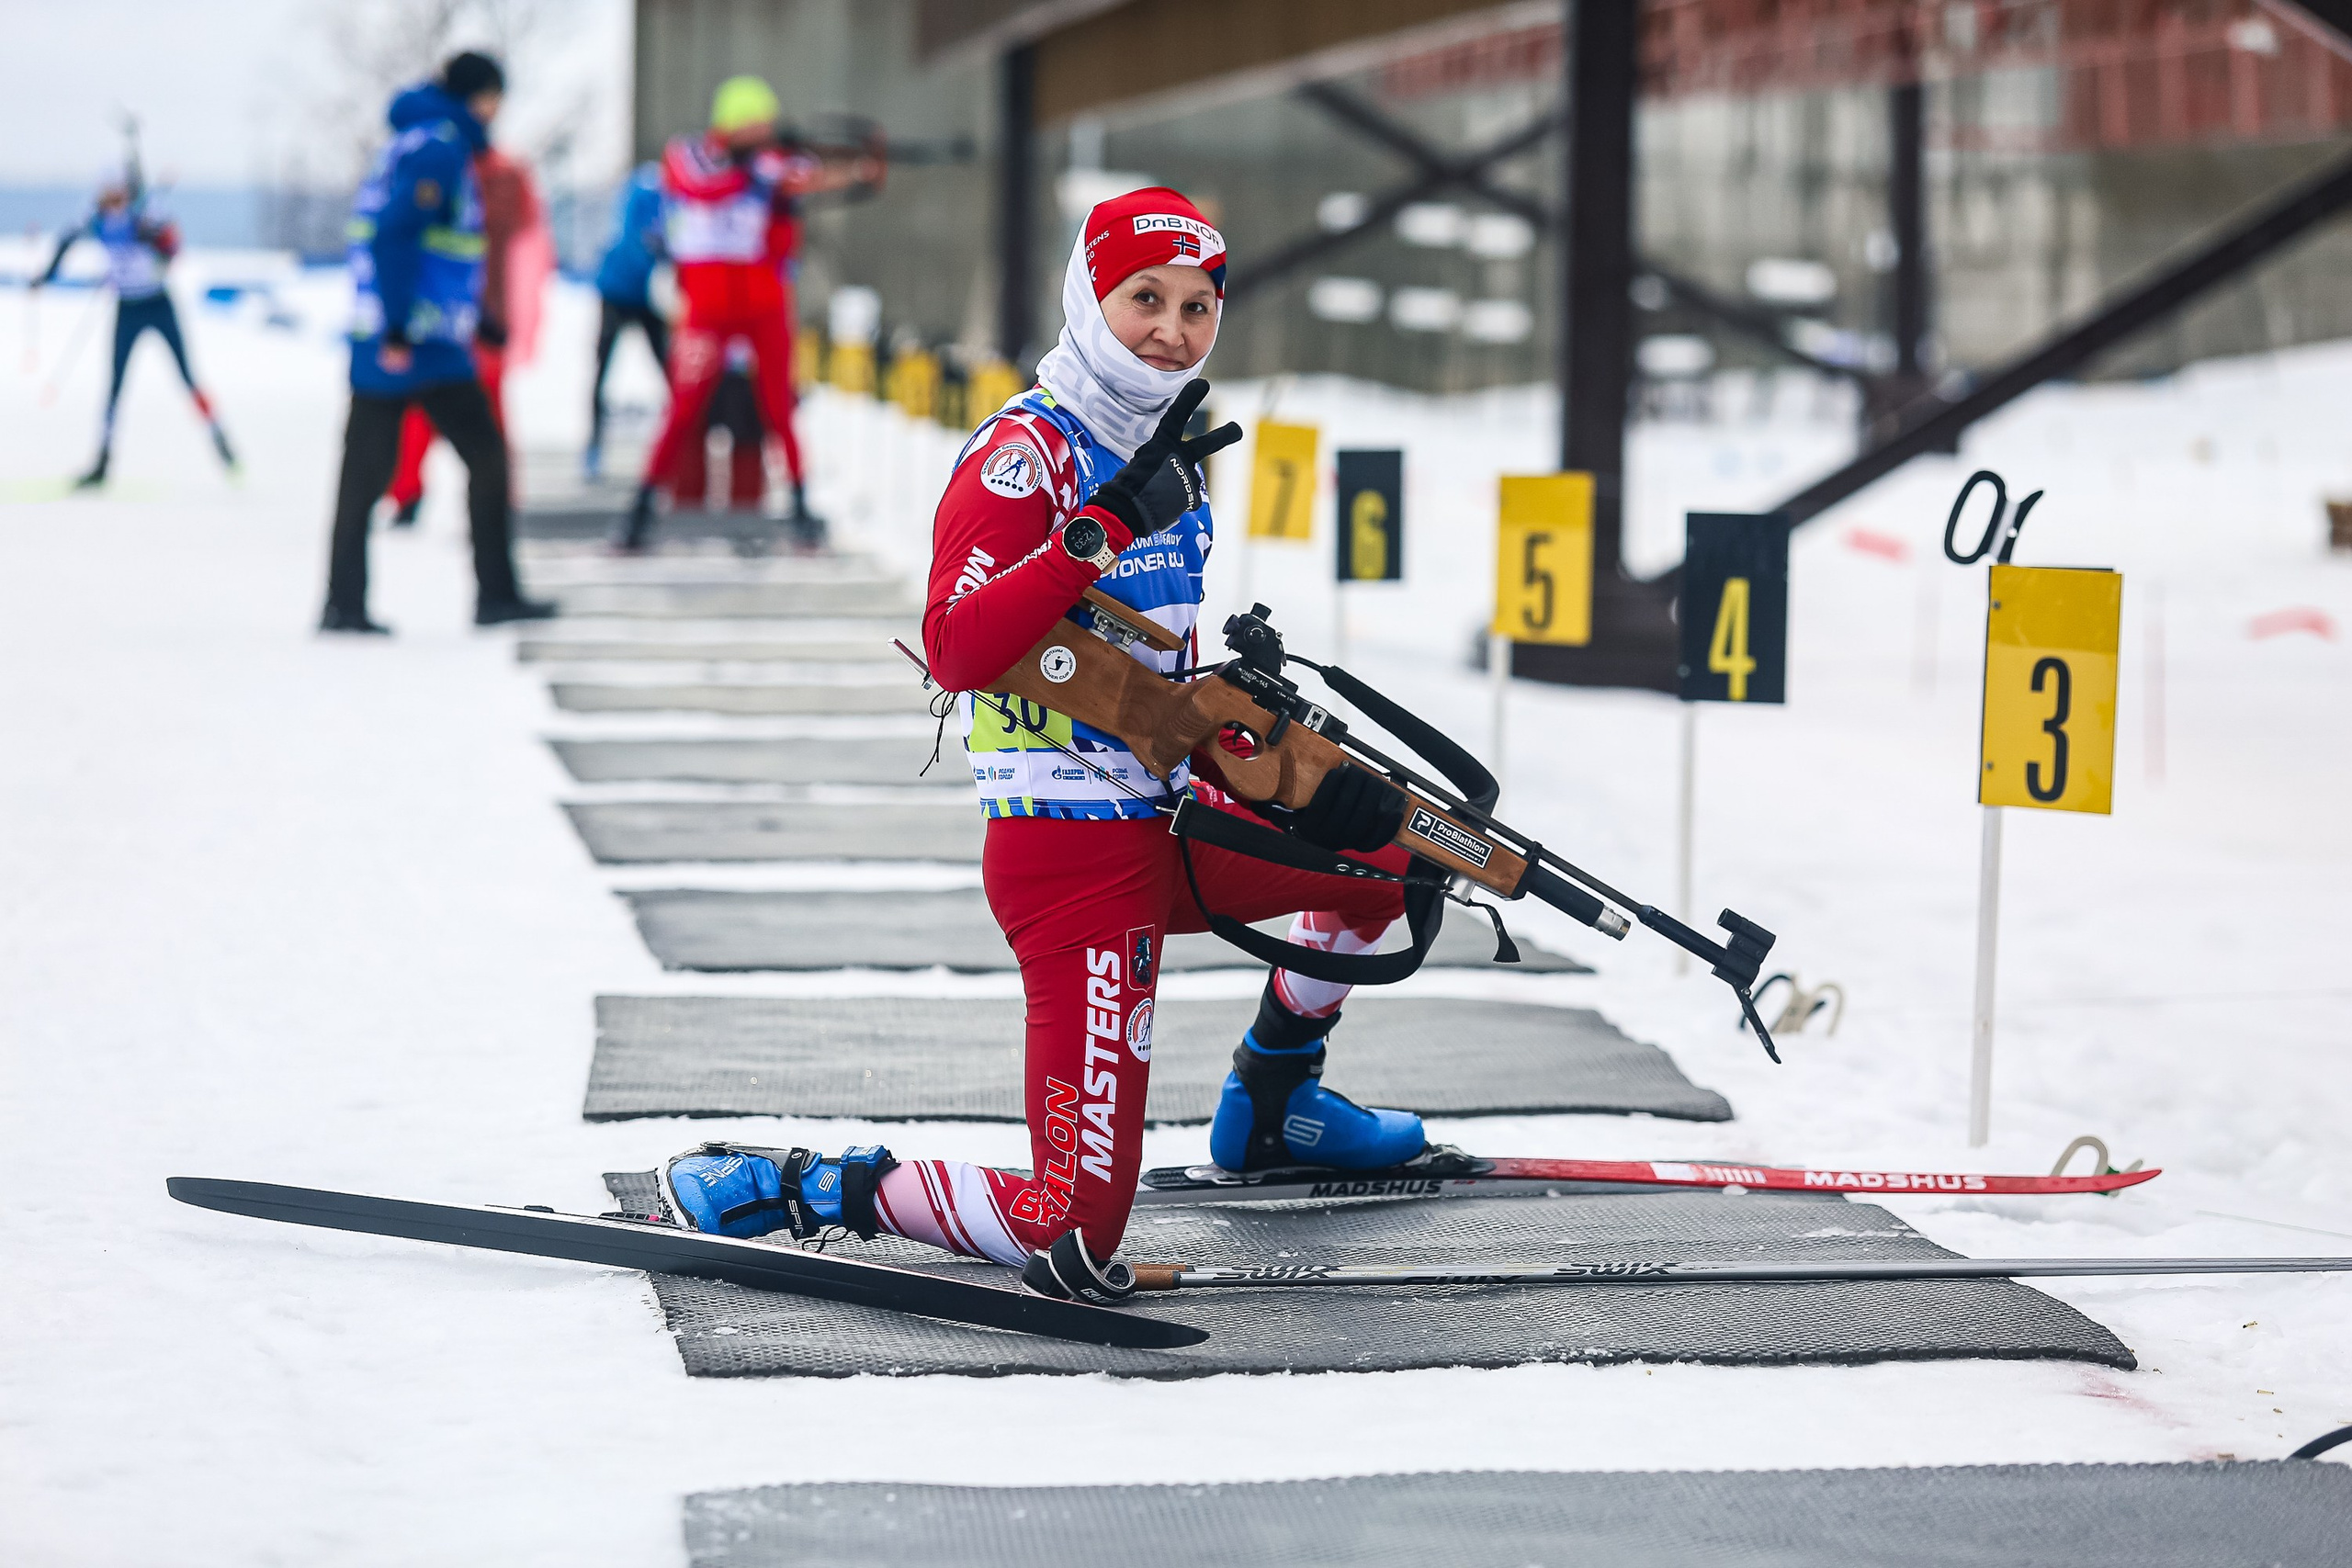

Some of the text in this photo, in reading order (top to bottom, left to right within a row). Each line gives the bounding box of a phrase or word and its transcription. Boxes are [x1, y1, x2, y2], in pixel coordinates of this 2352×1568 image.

[1350, 489, 1387, 581] 6
[1522, 531, 1555, 633] 5
[1708, 576, 1757, 701] 4
[2027, 656, 2072, 802] 3
[1081, 947, 1121, 1184] MASTERS
[1309, 1179, 1444, 1198] MADSHUS
[1804, 1171, 1987, 1190] MADSHUS
